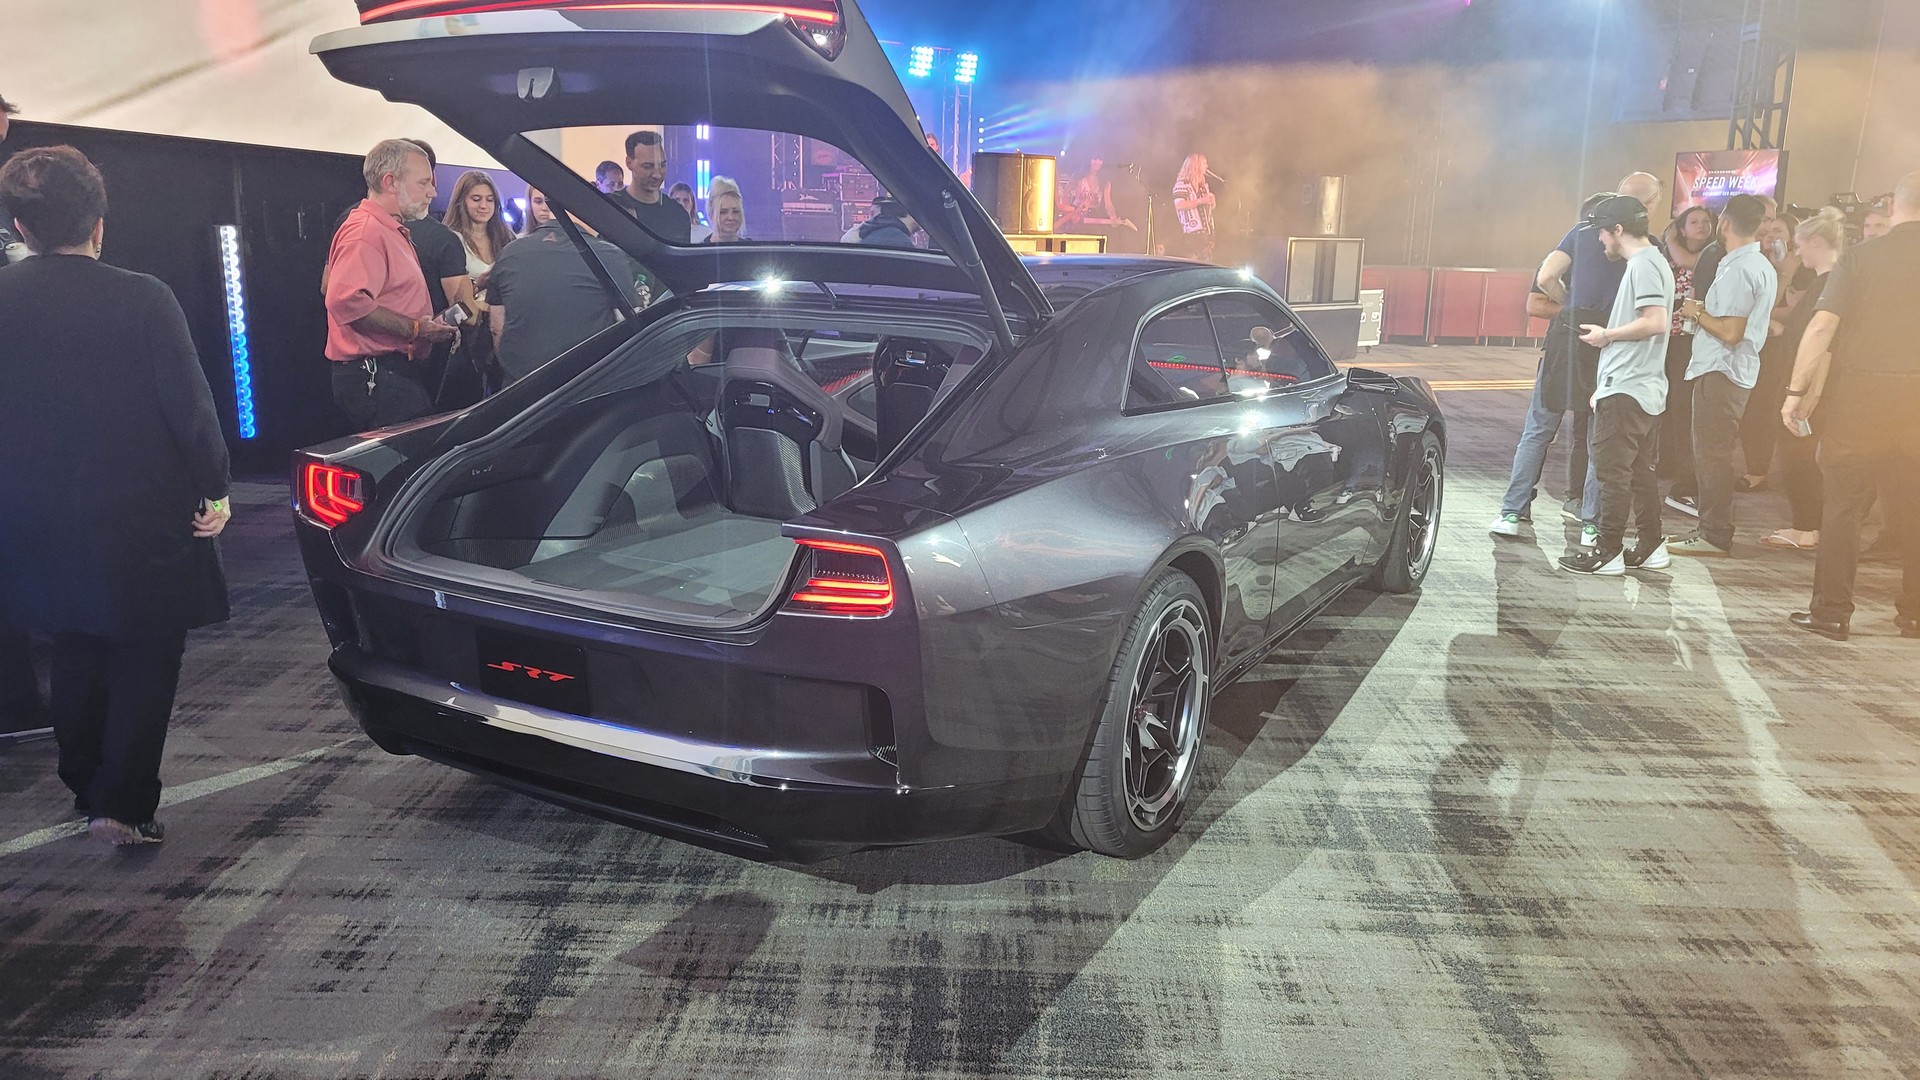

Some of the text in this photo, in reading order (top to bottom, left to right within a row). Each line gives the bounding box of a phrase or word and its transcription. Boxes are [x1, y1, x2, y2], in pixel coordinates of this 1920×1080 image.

[1693, 175, 1757, 189] SPEED WEEK
[487, 661, 575, 682] SRT
